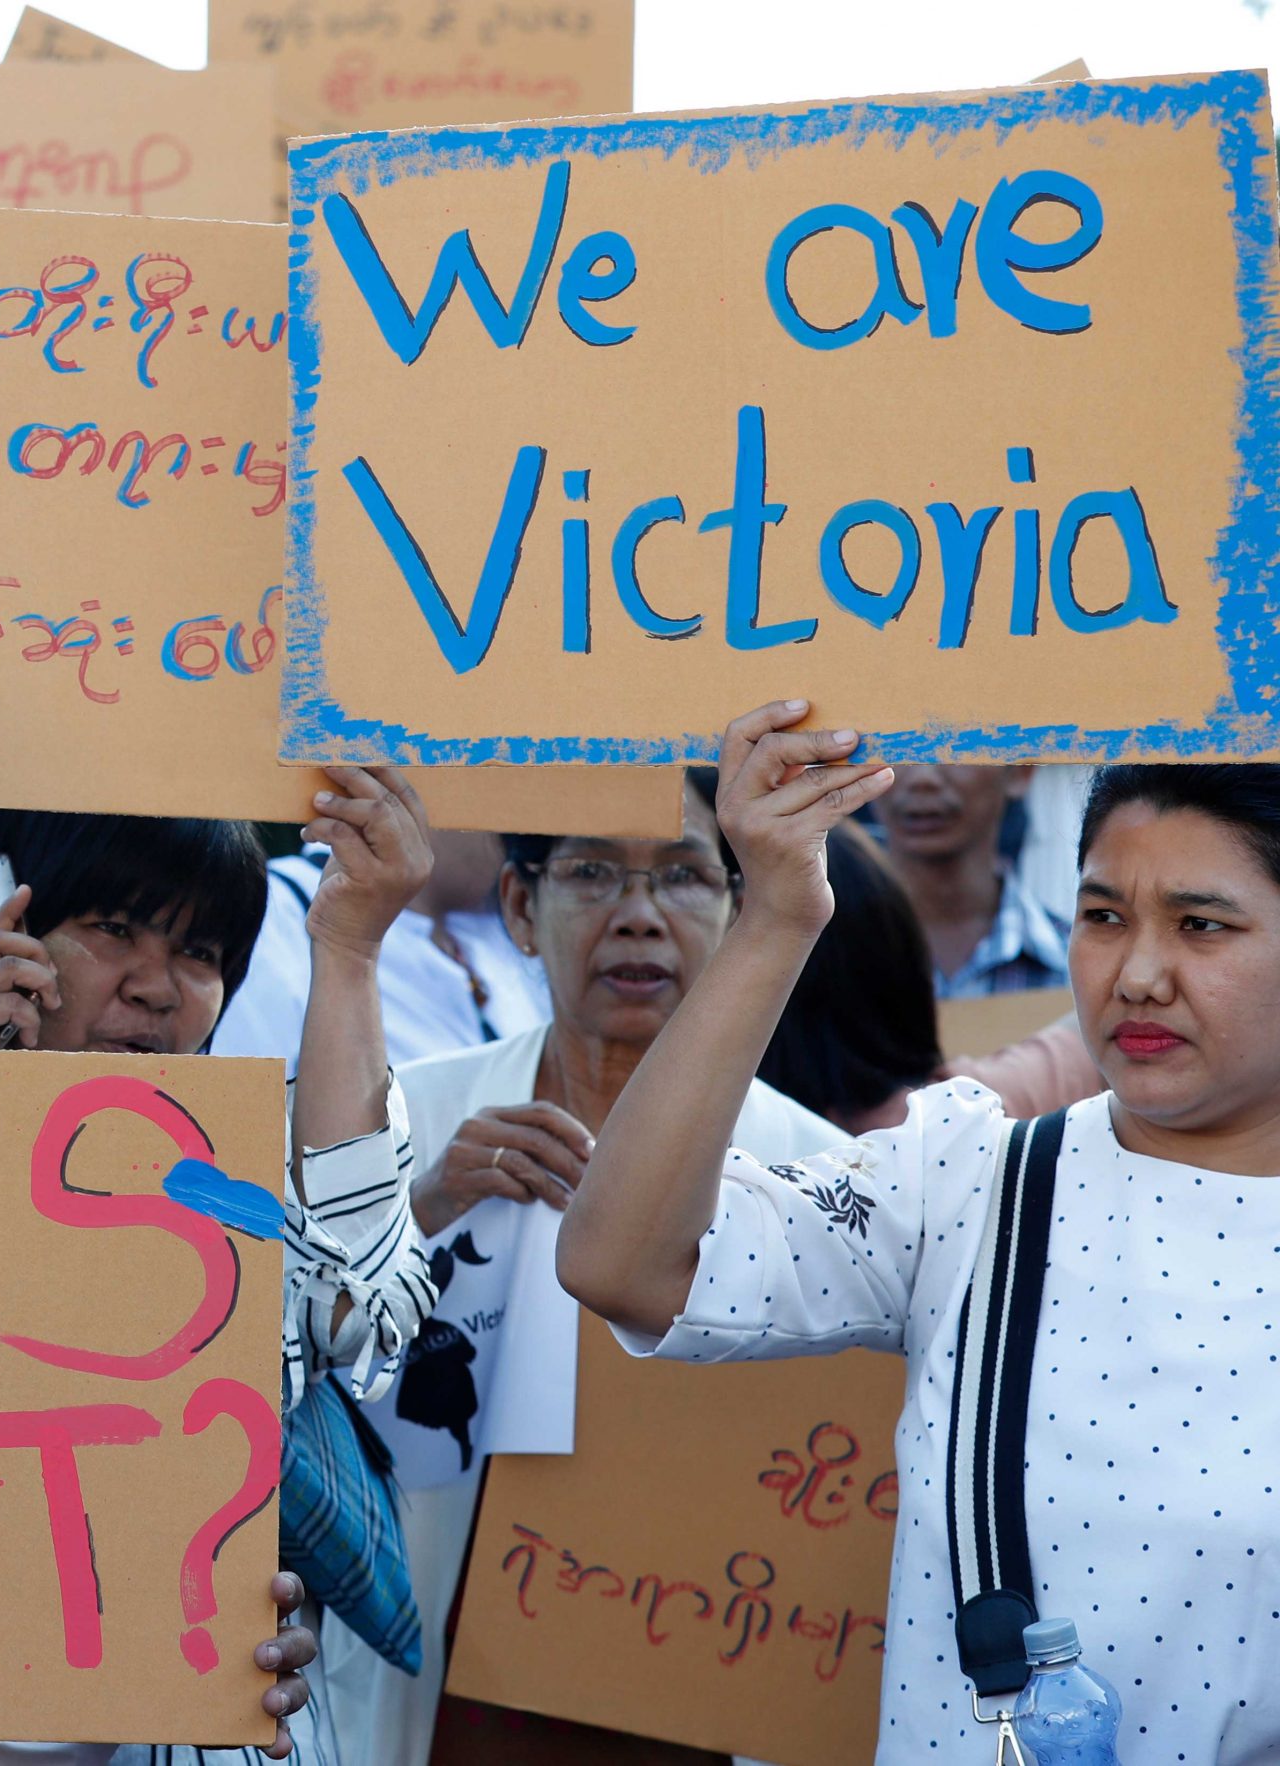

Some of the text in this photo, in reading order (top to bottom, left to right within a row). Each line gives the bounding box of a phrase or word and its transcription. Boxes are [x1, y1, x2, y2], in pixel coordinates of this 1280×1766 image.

[323, 160, 1104, 366] We are
[341, 404, 1180, 675] Victoria
